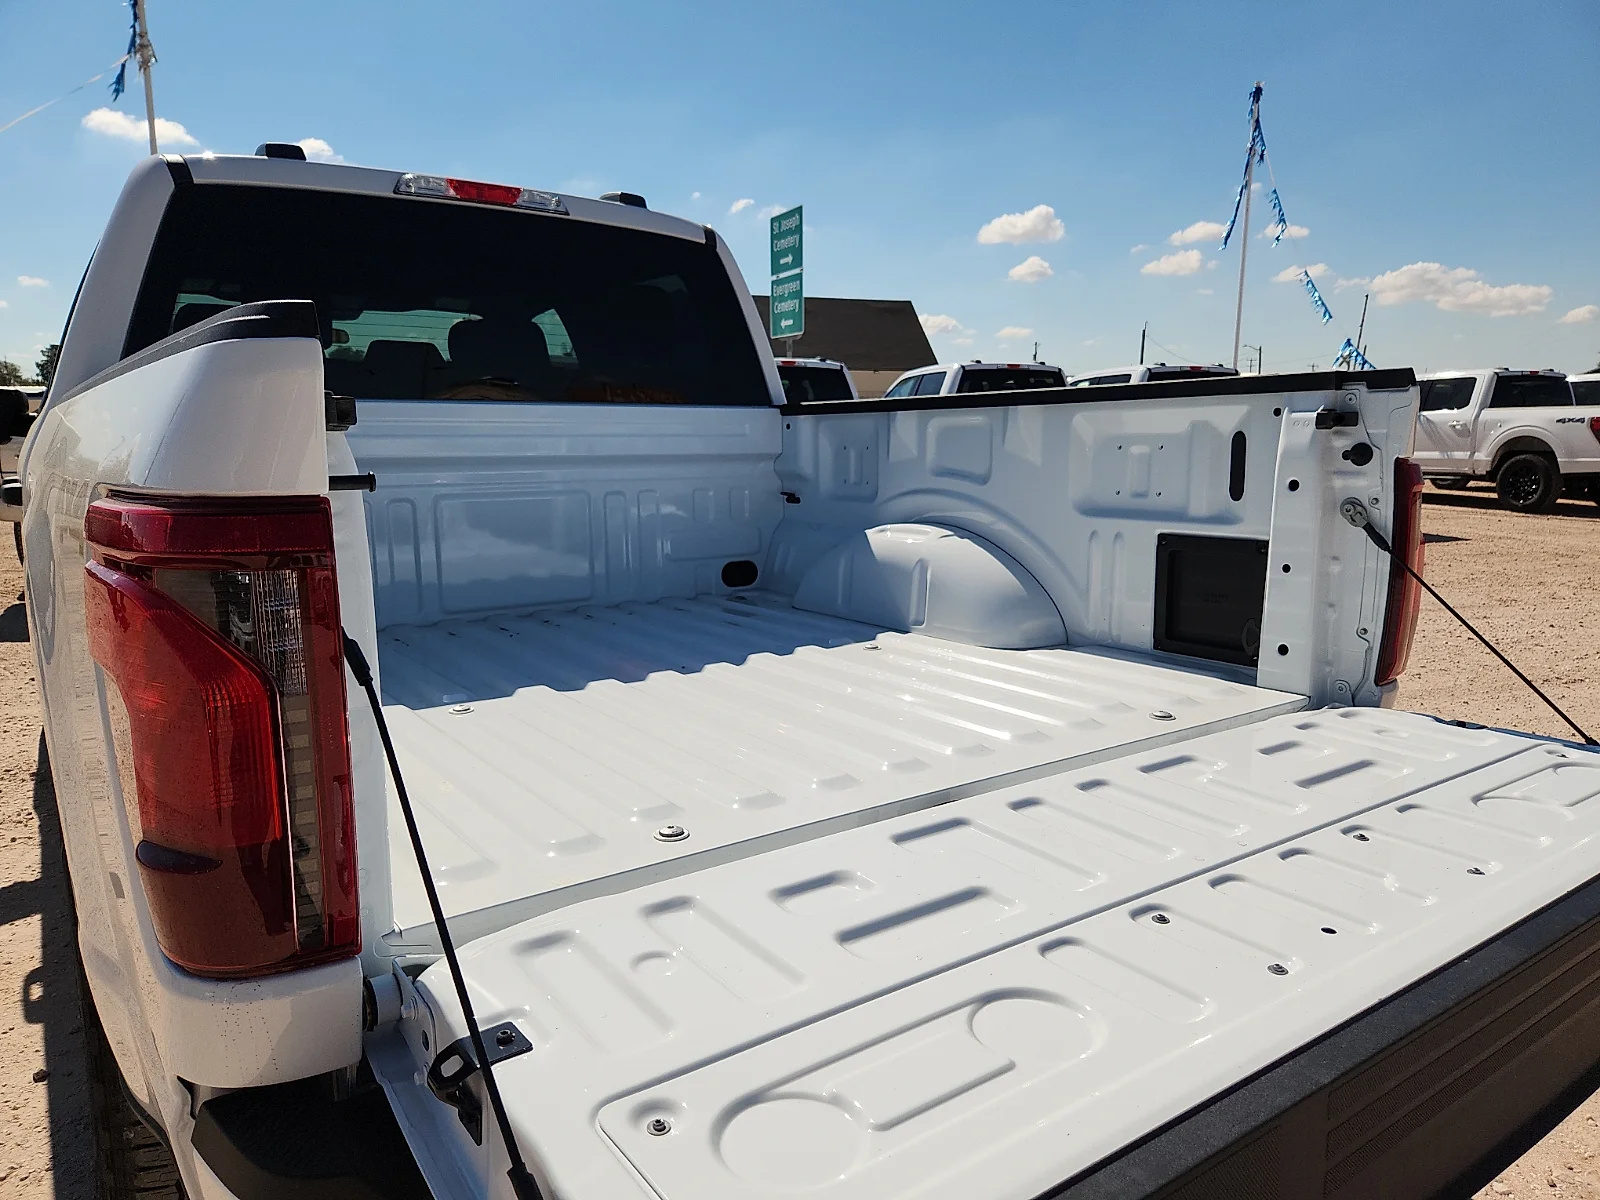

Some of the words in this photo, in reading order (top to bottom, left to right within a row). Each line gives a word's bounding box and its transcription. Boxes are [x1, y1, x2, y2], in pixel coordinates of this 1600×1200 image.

[772, 221, 779, 234] St
[780, 213, 800, 232] Joseph
[773, 234, 800, 252] Cemetery
[773, 280, 800, 297] Evergreen
[773, 299, 800, 314] Cemetery
